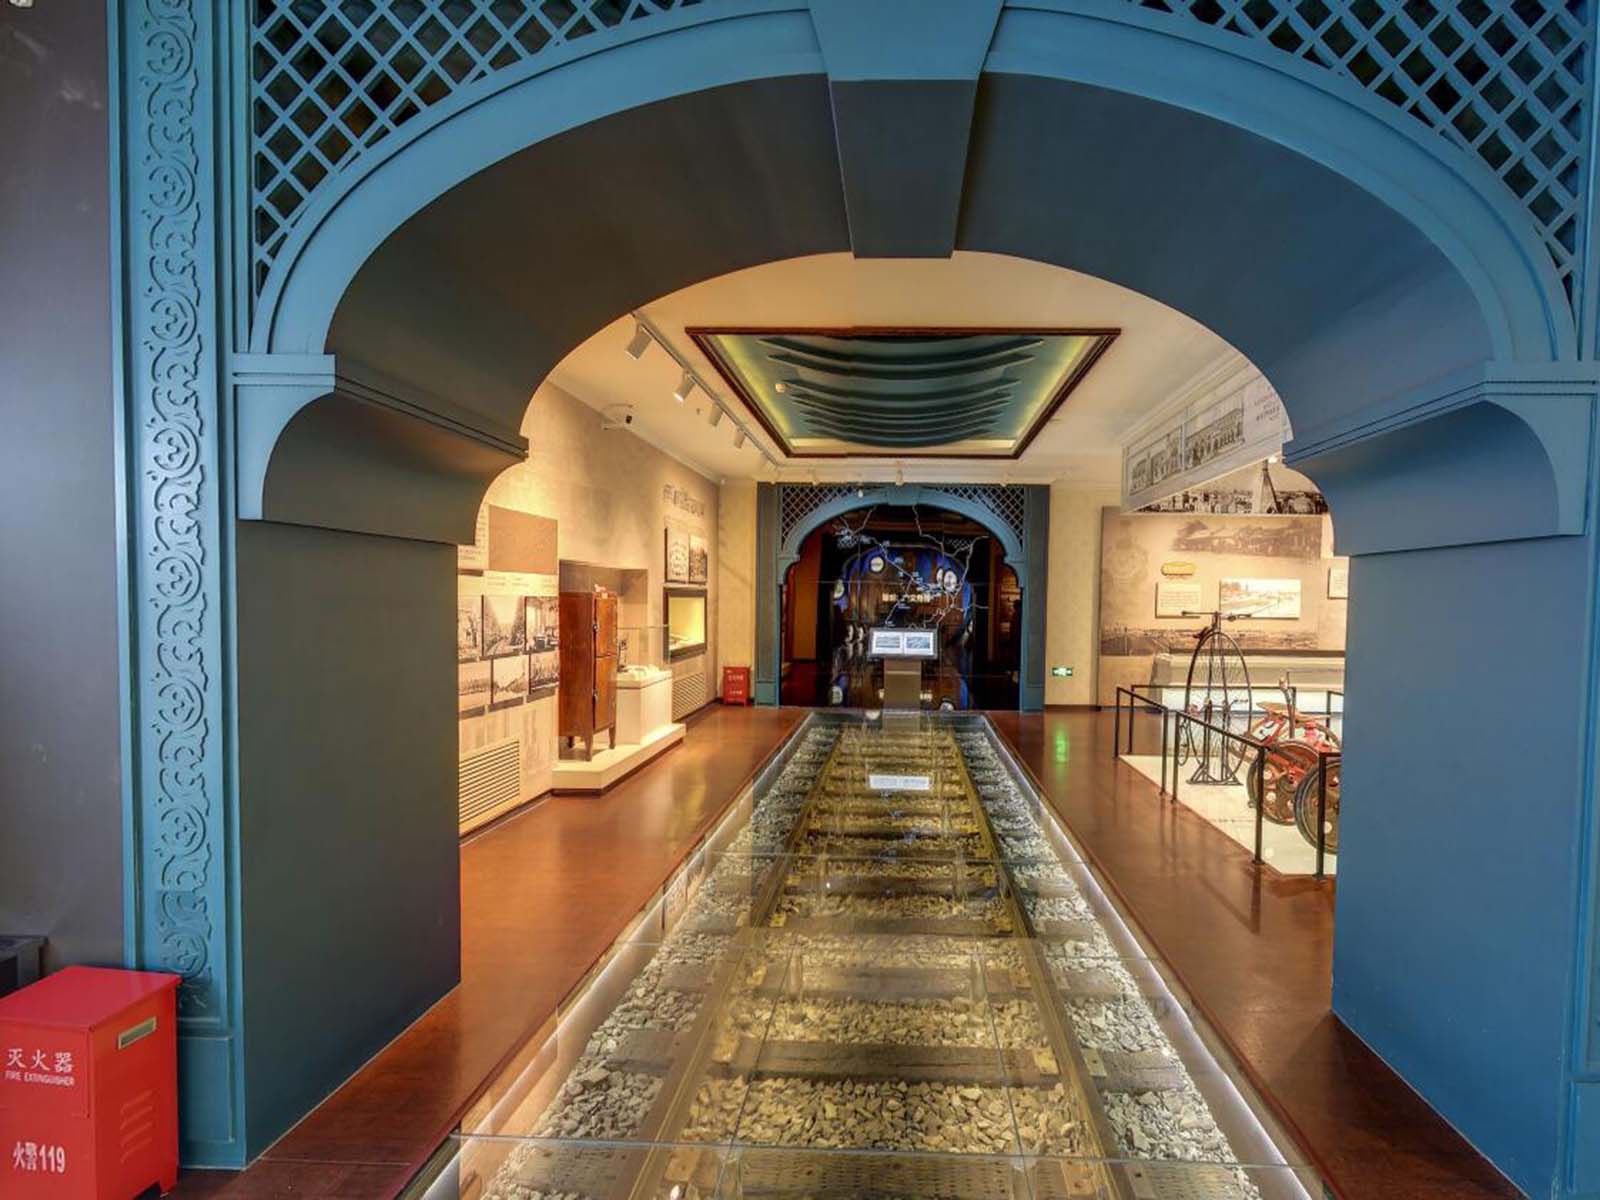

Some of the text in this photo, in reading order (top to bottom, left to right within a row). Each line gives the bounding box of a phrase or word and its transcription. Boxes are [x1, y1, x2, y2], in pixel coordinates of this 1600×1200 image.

[7, 1048, 74, 1073] 灭火器
[5, 1070, 75, 1086] FIRE EXTINGUISHER
[13, 1141, 66, 1174] 火警119
